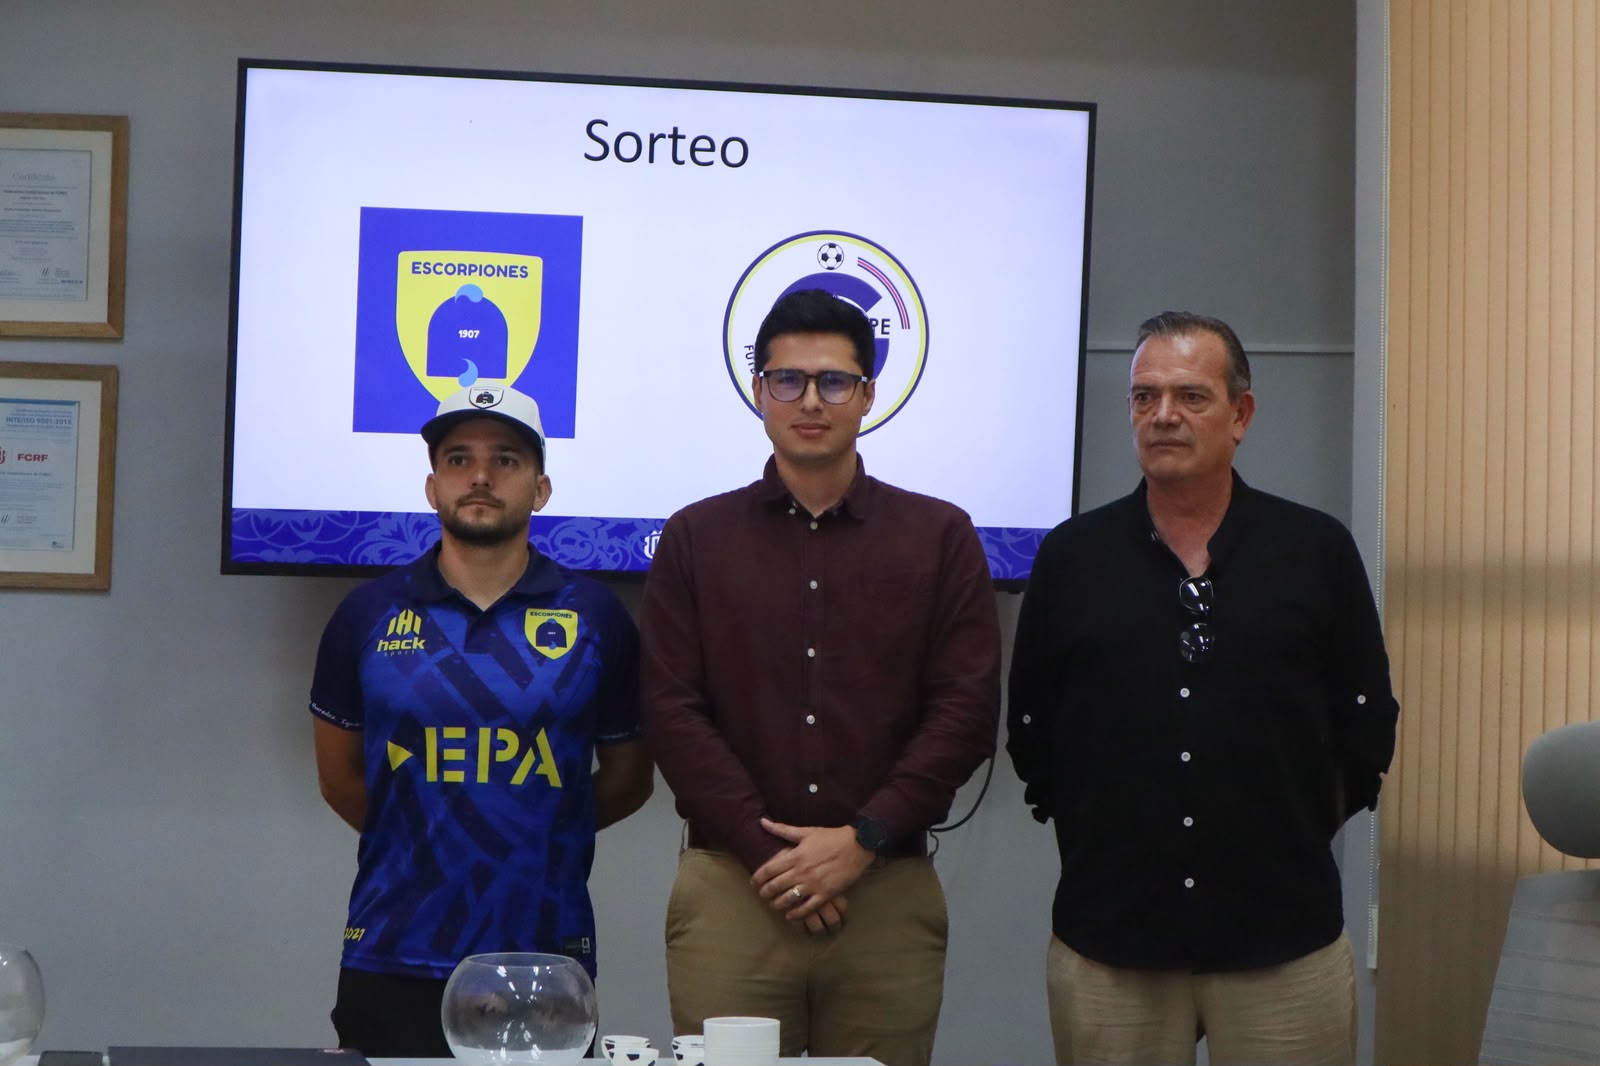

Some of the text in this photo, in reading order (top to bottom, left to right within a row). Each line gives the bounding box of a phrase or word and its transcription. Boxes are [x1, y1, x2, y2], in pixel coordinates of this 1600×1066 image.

[584, 119, 749, 168] Sorteo
[411, 261, 529, 278] ESCORPIONES
[458, 329, 480, 339] 1907
[17, 453, 48, 461] FCRF
[376, 637, 426, 652] hack
[425, 727, 562, 788] EPA
